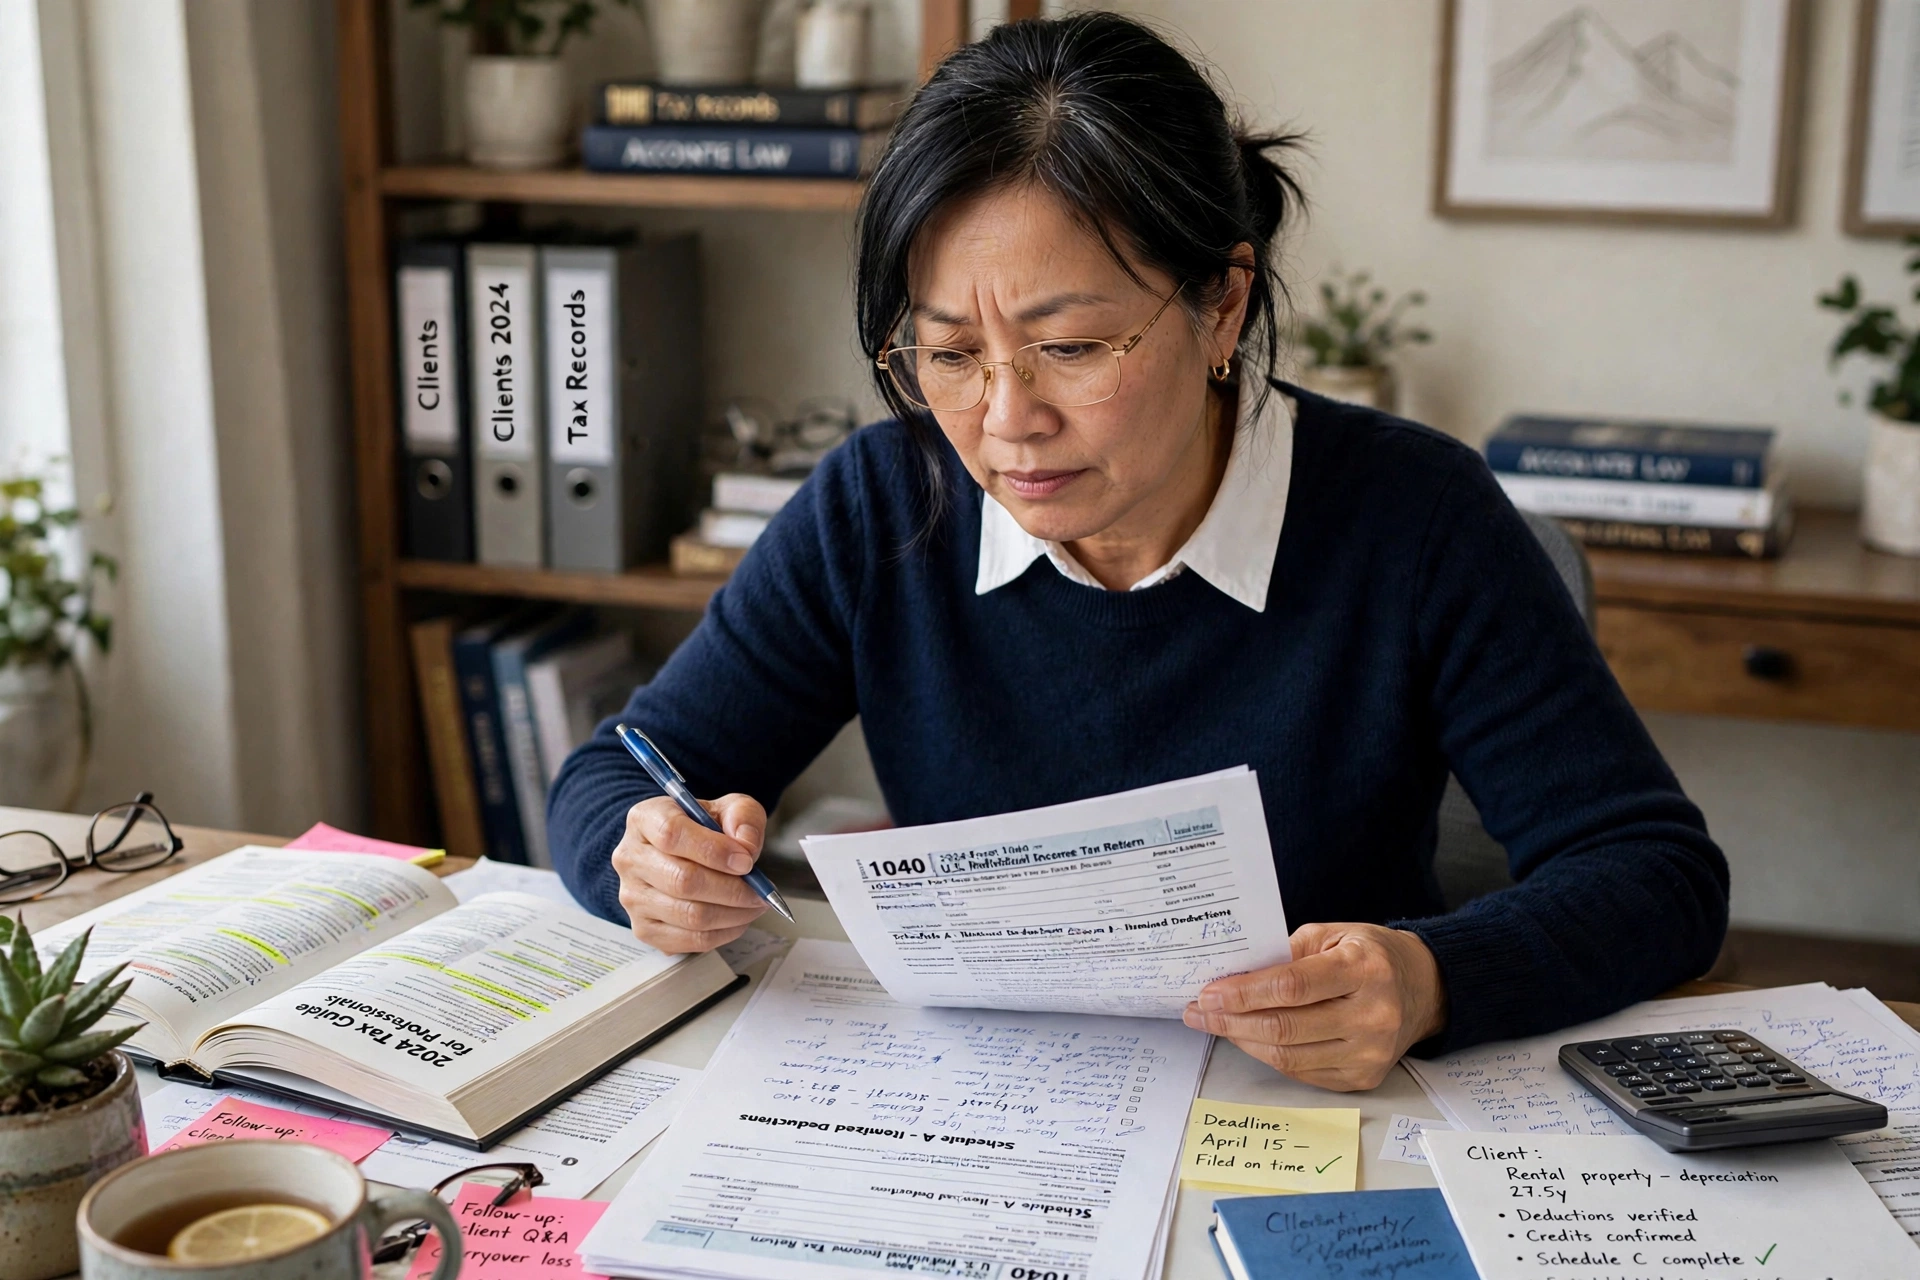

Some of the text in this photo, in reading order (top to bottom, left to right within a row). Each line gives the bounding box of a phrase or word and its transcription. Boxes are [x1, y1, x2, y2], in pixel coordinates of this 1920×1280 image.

[417, 319, 440, 411] Clients
[488, 282, 515, 442] Clients 2024
[563, 289, 588, 445] Tax Records
[869, 858, 926, 877] 1040
[324, 995, 442, 1043] Professionals
[295, 1003, 453, 1068] 2024 Tax Guide
[212, 1112, 304, 1140] Follow-up:
[1203, 1113, 1290, 1132] Deadline:
[188, 1128, 235, 1141] client
[923, 1133, 937, 1142] A
[940, 1135, 1016, 1150] Schedule
[1201, 1133, 1248, 1150] April
[1263, 1138, 1287, 1150] 15
[1196, 1153, 1306, 1173] Filed on time
[1506, 1167, 1565, 1181] Rental
[1581, 1169, 1651, 1187] property
[1679, 1169, 1779, 1185] depreciation
[1510, 1185, 1567, 1203] 27.5y
[461, 1202, 564, 1228] Follow-up:
[1516, 1208, 1698, 1222] Deductions verified
[523, 1228, 568, 1244] Q&A
[1526, 1229, 1696, 1243] Credits confirmed
[541, 1251, 572, 1267] loss
[1536, 1252, 1745, 1269] Schedule C complete
